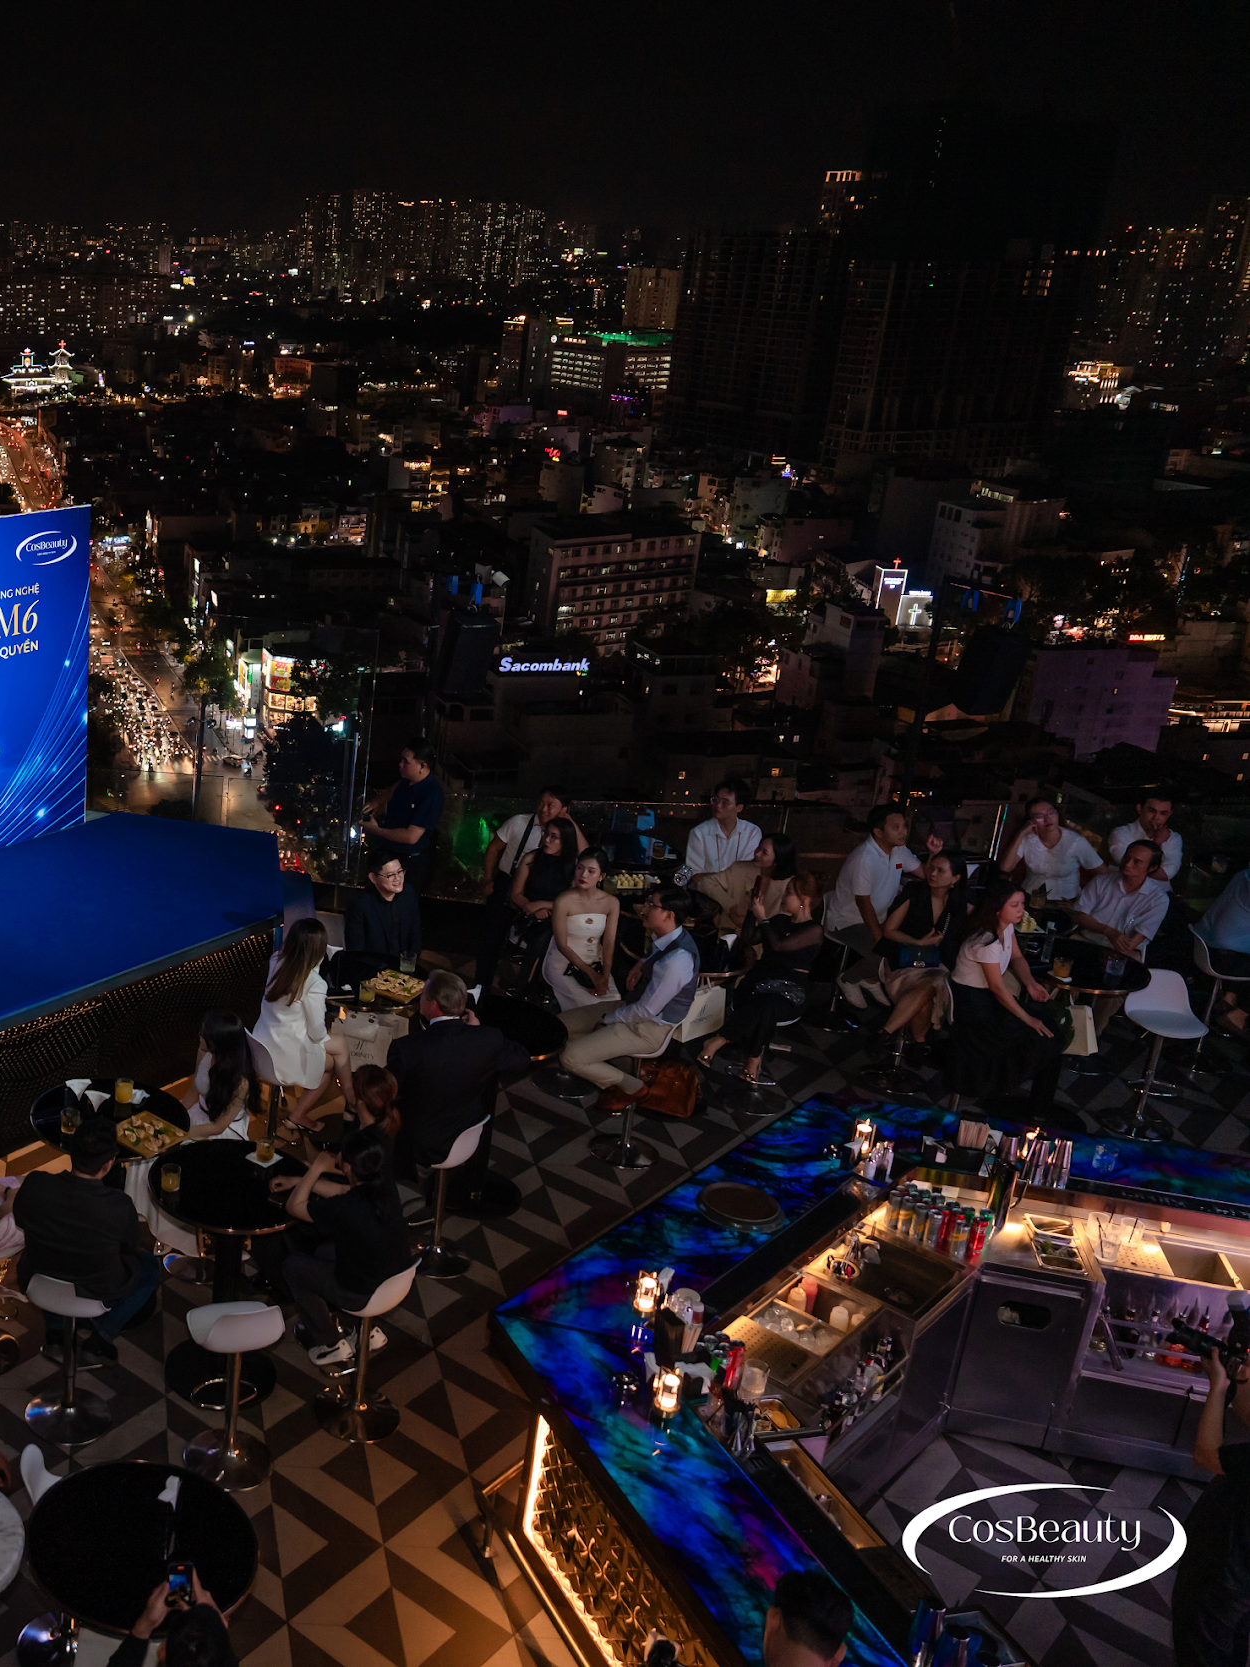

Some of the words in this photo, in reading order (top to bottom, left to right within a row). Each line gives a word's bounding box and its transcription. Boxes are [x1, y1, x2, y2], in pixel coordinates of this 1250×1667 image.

[25, 538, 68, 552] CosBeauty
[15, 582, 40, 597] NGHỆ
[0, 638, 39, 659] QUYỀN
[499, 656, 590, 672] Sacombank
